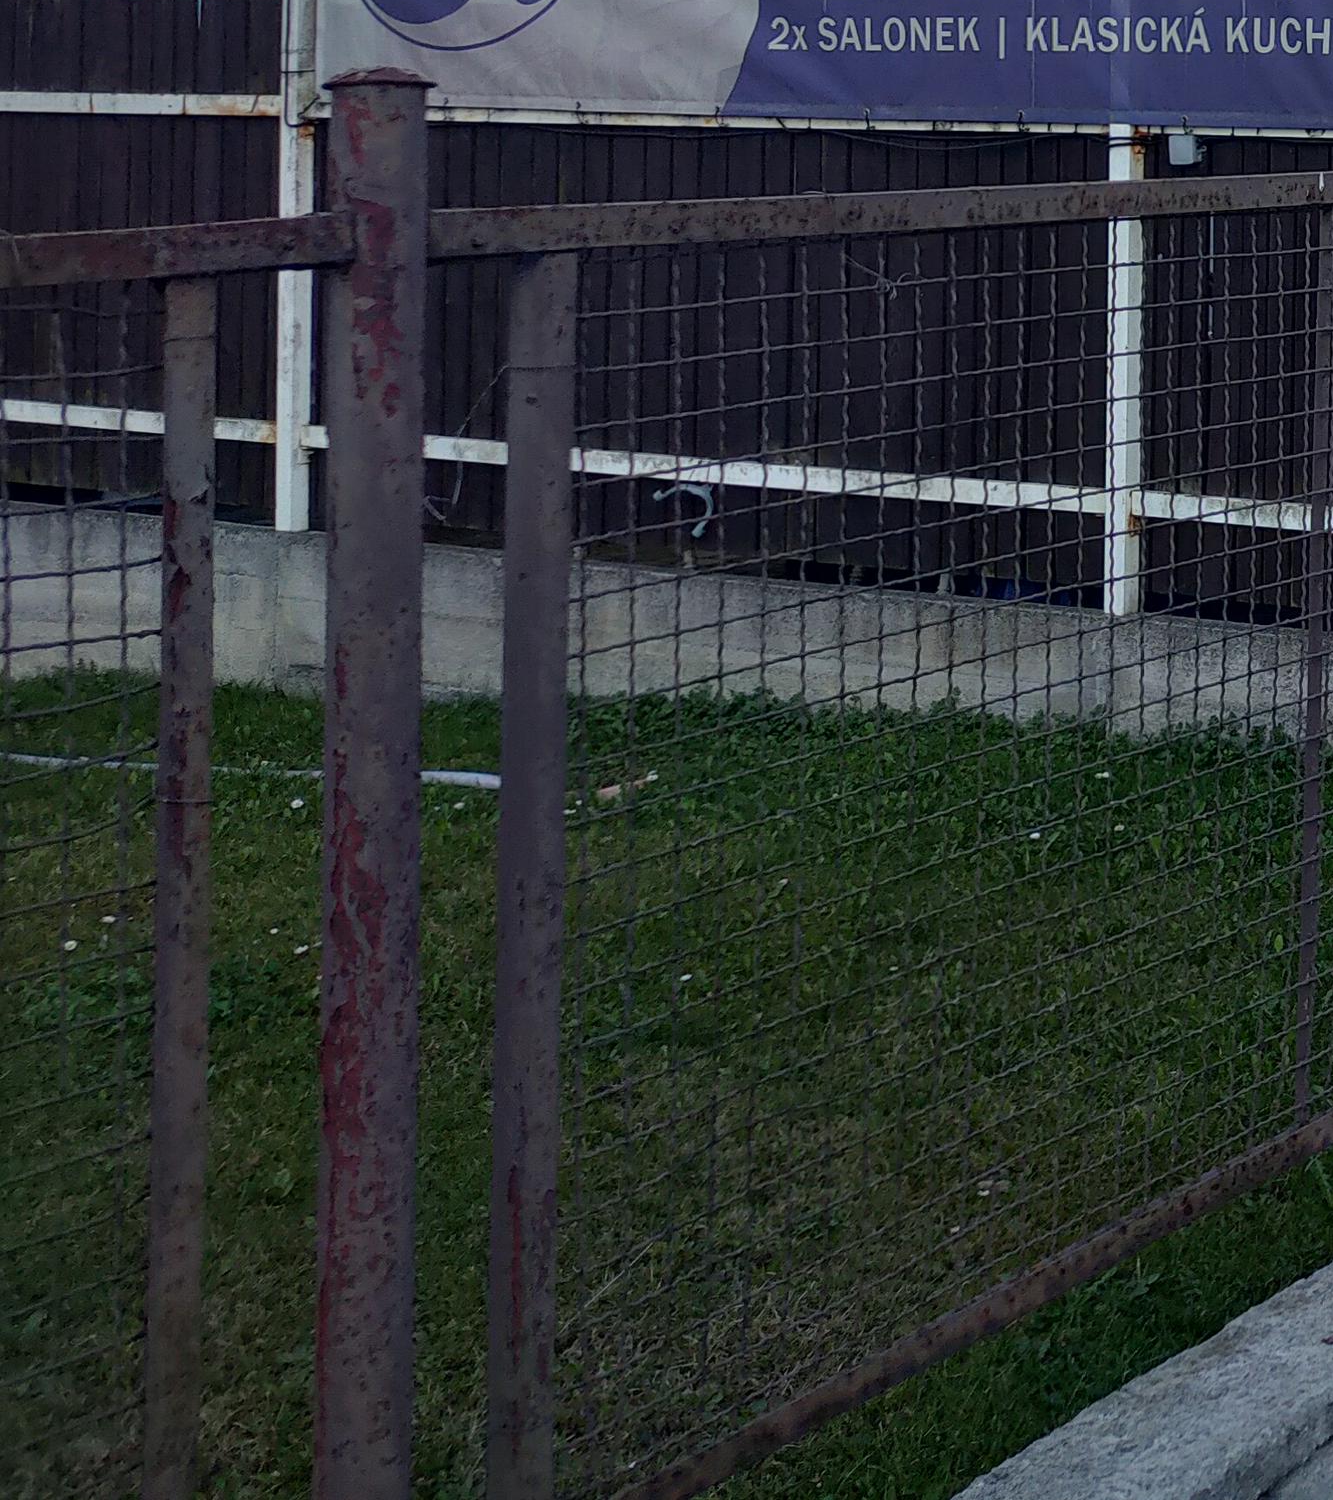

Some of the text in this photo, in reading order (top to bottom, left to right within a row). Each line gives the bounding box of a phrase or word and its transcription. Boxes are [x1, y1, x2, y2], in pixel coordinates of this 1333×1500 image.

[767, 16, 809, 51] 2x
[817, 16, 980, 52] SALONEK
[1025, 8, 1211, 53] KLASICKÁ
